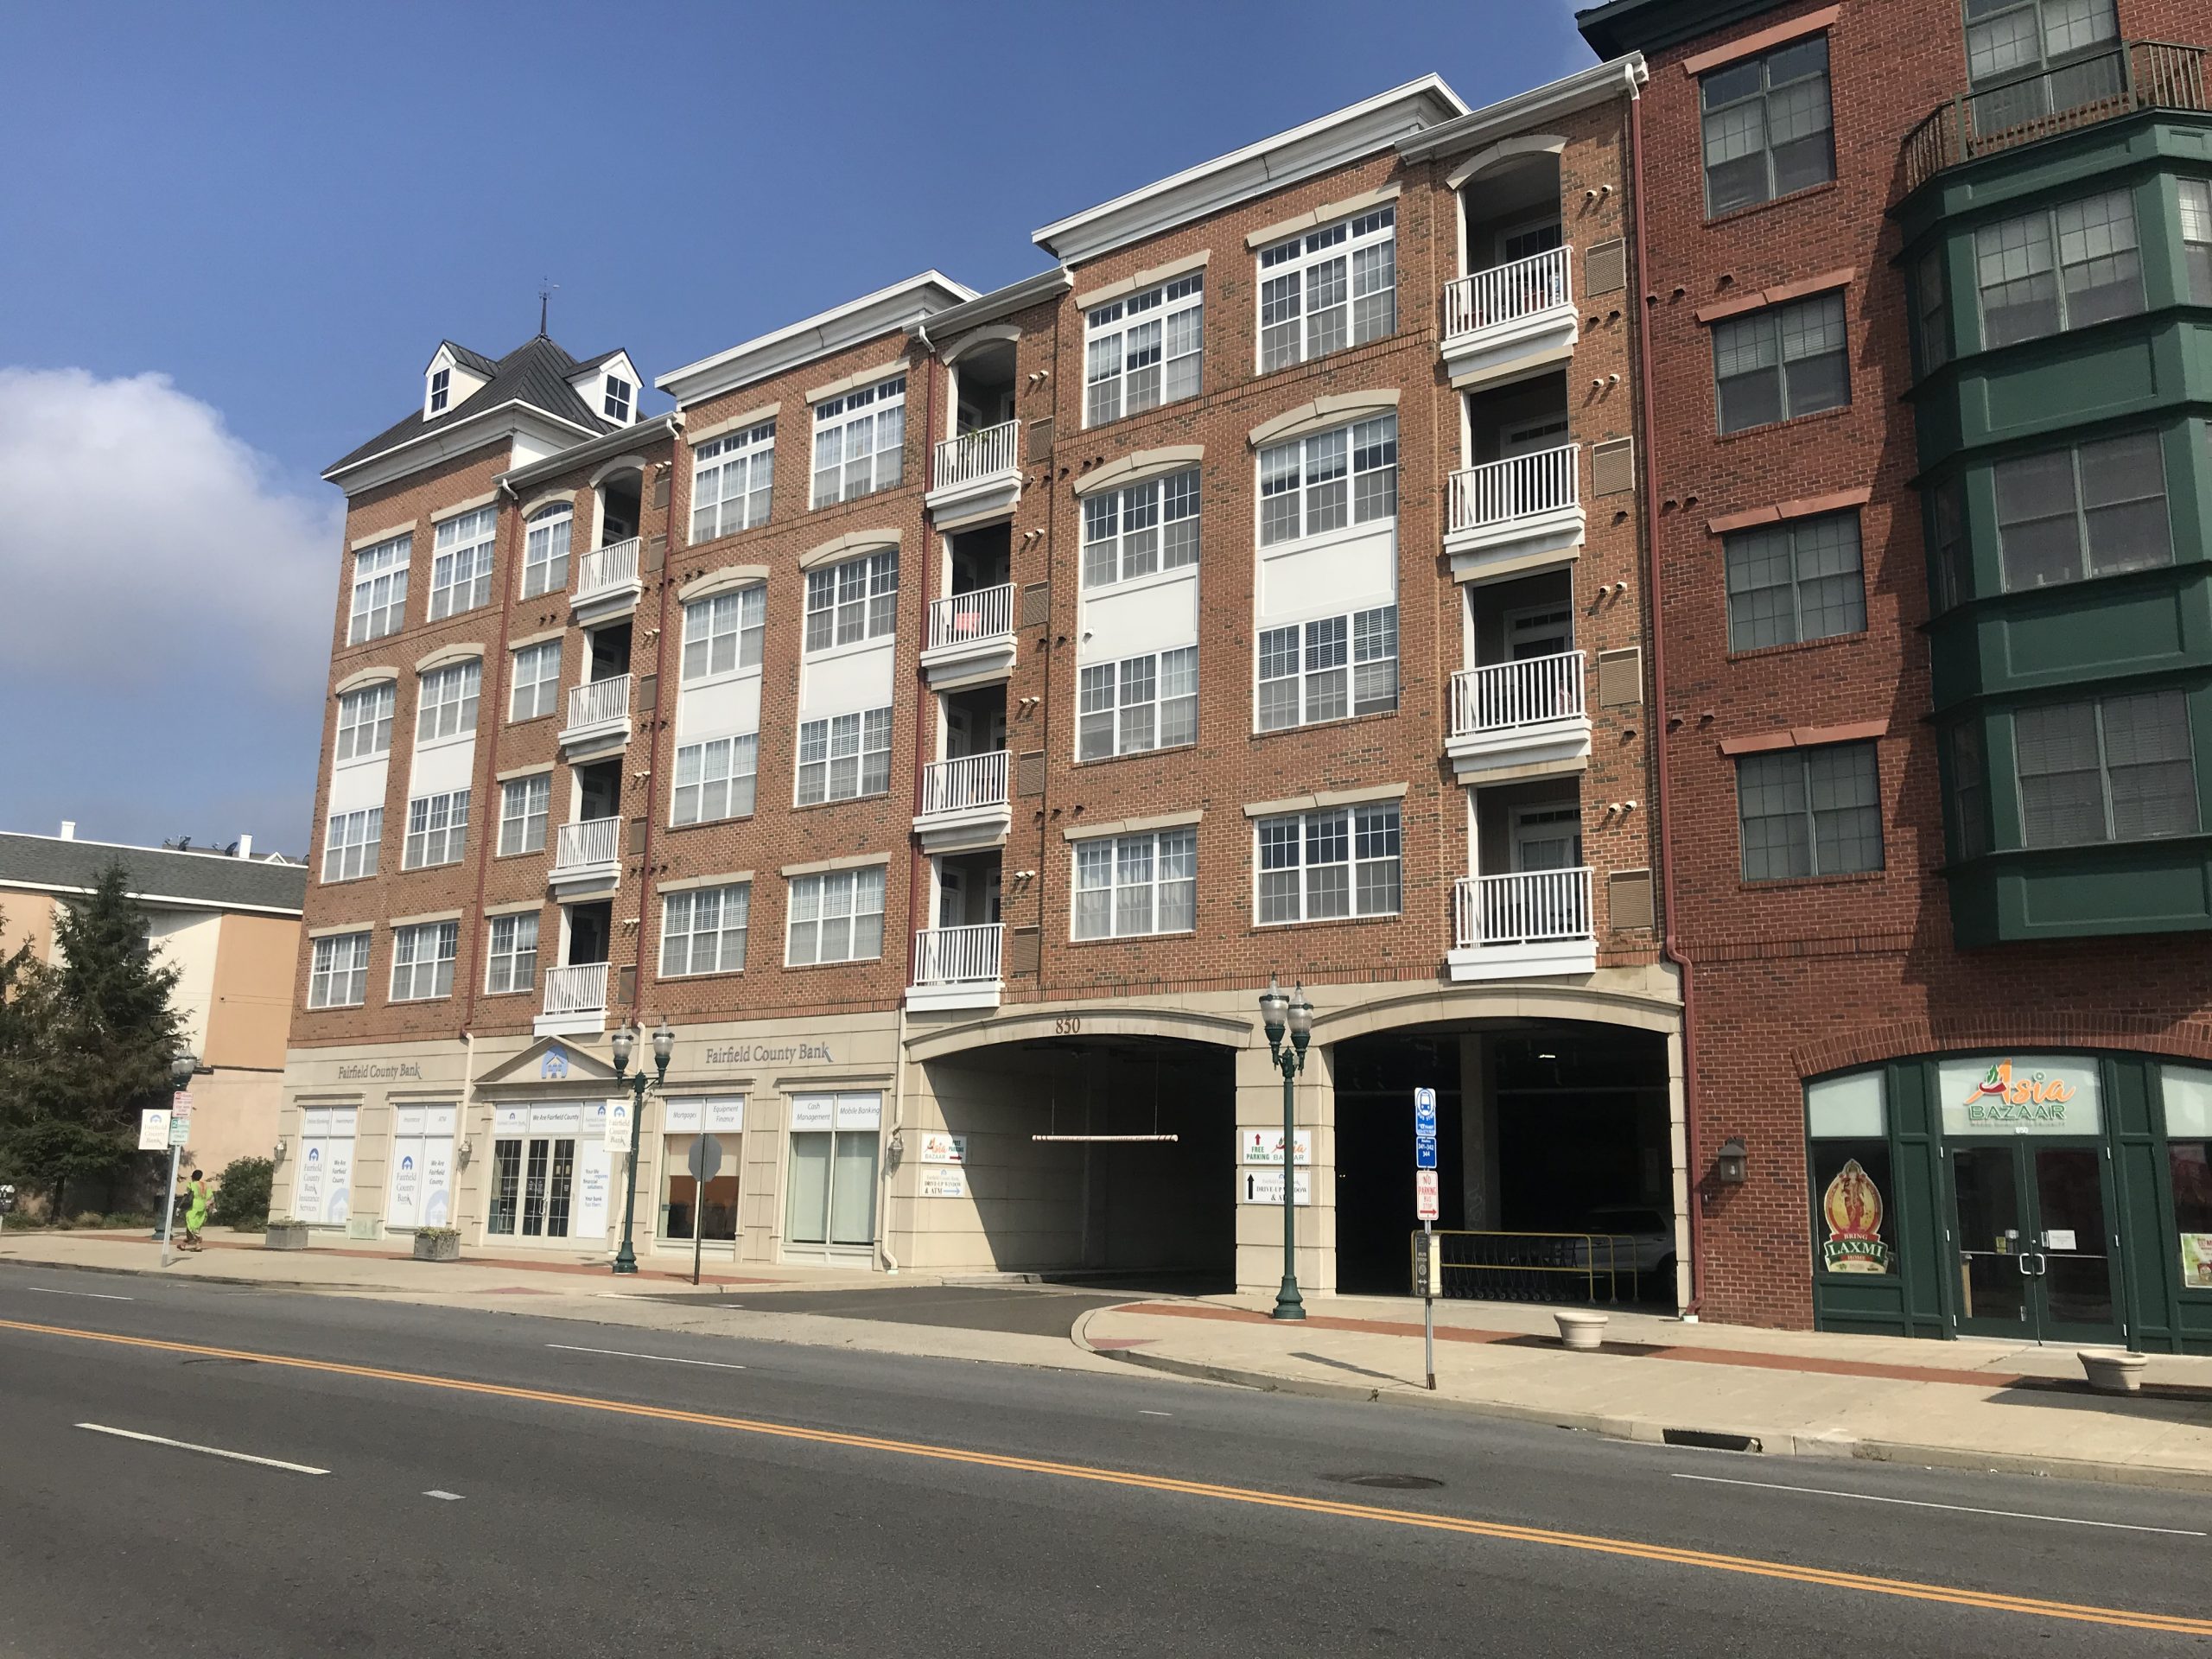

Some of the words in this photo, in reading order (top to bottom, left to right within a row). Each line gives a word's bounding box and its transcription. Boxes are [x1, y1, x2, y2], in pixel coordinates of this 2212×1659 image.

[1056, 1017, 1080, 1034] 850
[705, 1045, 751, 1064] Fairfield
[753, 1045, 797, 1064] County
[798, 1041, 834, 1063] Bank
[338, 1065, 369, 1078] Fairfield
[370, 1065, 398, 1080] County
[399, 1062, 422, 1079] Bank
[1963, 1057, 2076, 1105] Asia
[807, 1102, 820, 1110] Cash
[858, 1107, 880, 1116] Banking
[673, 1111, 697, 1120] Mortgages
[796, 1113, 830, 1122] Management
[1969, 1105, 2066, 1120] BAZAAR
[1423, 1176, 1431, 1185] NO
[1418, 1186, 1436, 1195] PARKING
[1828, 1242, 1883, 1256] LAXMI
